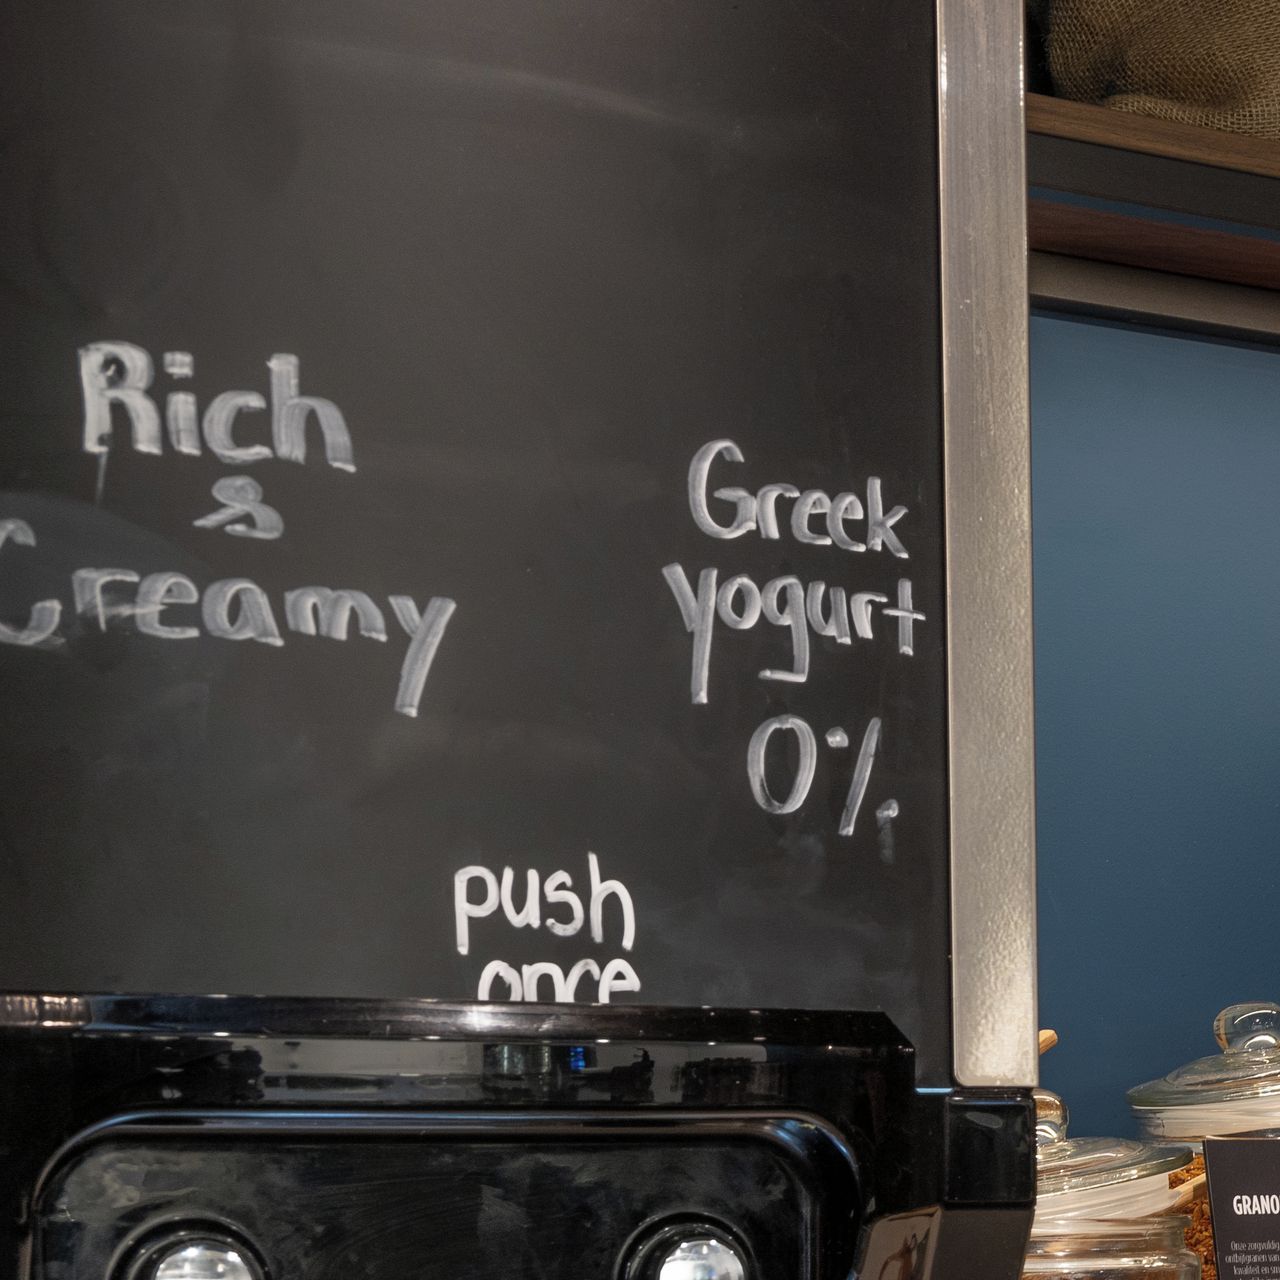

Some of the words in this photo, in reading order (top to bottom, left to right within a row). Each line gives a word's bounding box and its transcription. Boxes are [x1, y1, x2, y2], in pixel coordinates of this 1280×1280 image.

[78, 341, 356, 472] Rich
[688, 439, 909, 558] Greek
[662, 563, 927, 704] yogurt
[747, 715, 898, 838] 0%
[454, 852, 635, 955] push
[1261, 1266, 1269, 1274] en
[1268, 1254, 1279, 1262] van
